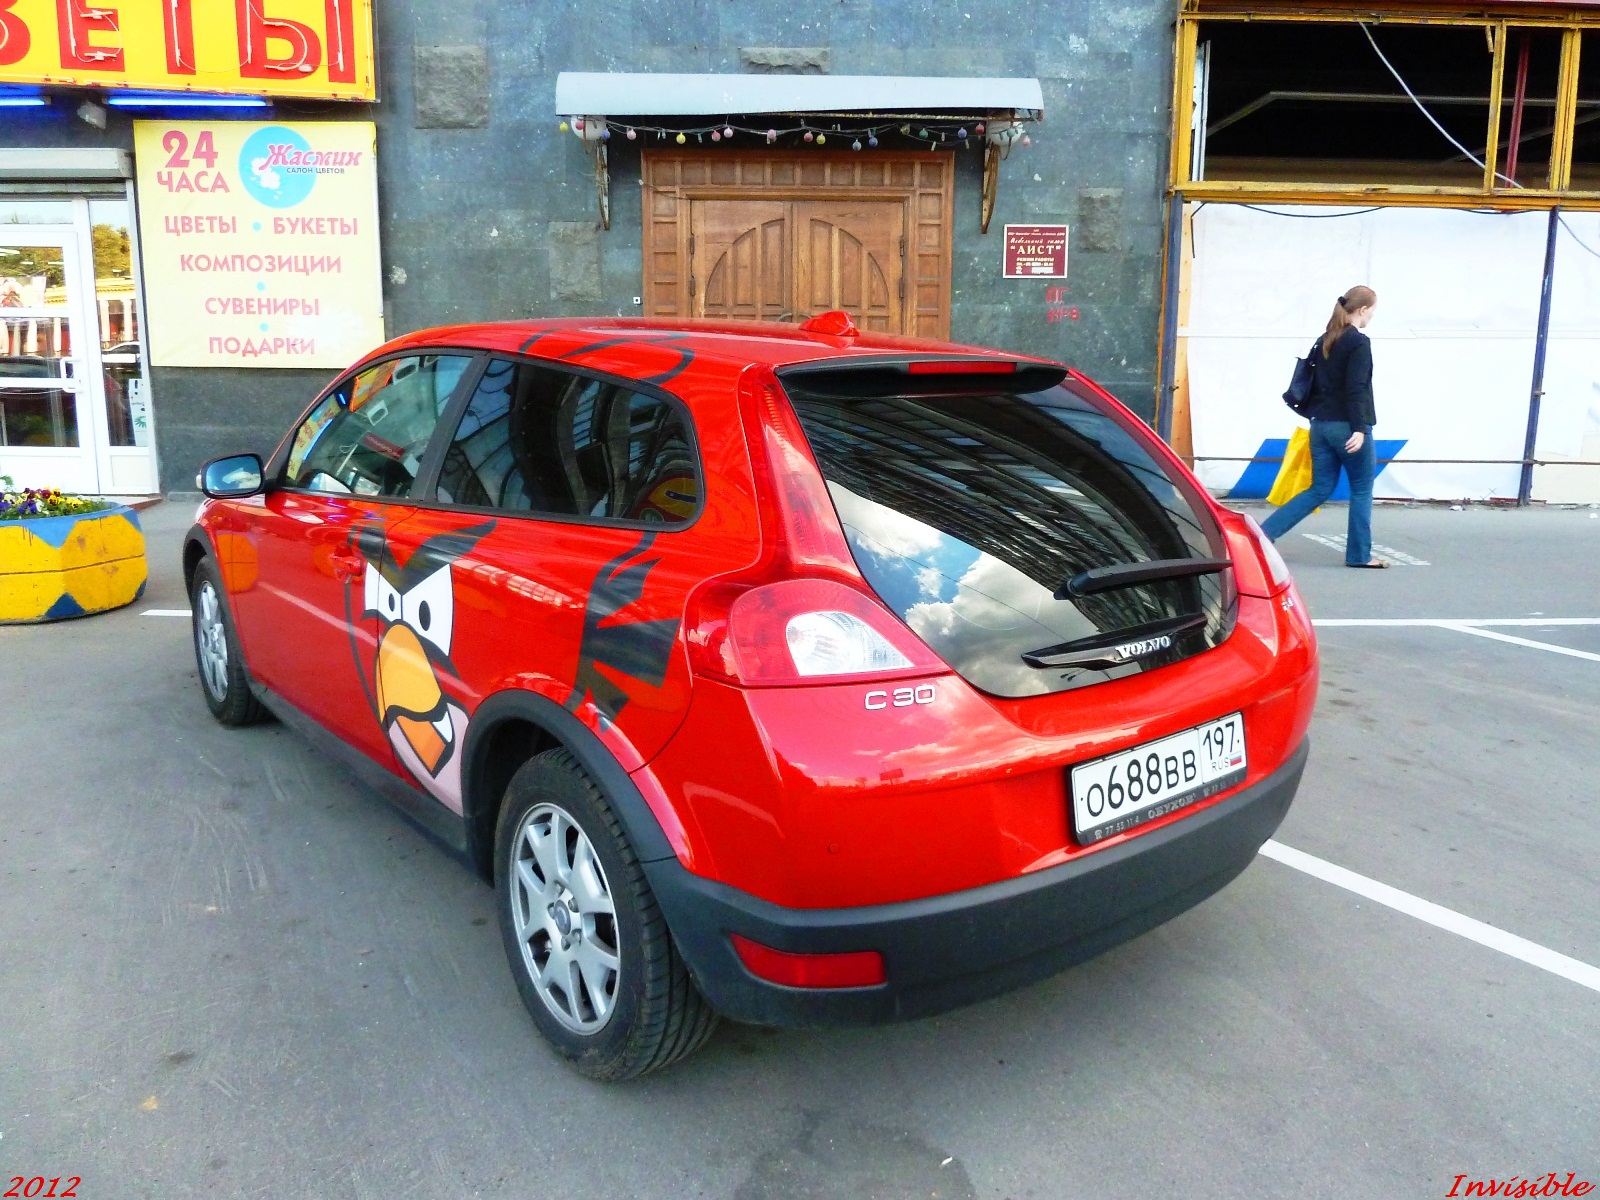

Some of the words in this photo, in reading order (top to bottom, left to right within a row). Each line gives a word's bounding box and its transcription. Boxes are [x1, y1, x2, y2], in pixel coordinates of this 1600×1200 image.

[162, 130, 218, 168] 24
[258, 144, 363, 171] Жасмин
[157, 170, 230, 193] ЧАСА
[315, 167, 345, 175] ЦВЕТОВ
[164, 215, 237, 236] ЦВЕТЫ
[273, 217, 358, 235] БУКЕТЫ
[180, 254, 341, 276] КОМПОЗИЦИИ
[205, 297, 319, 316] СУВЕНИРЫ
[209, 336, 315, 358] ПОДАРКИ
[1115, 636, 1171, 658] VOLVO
[865, 690, 887, 710] C
[893, 685, 936, 707] 30
[1203, 721, 1235, 760] 197
[1212, 756, 1229, 773] RUS
